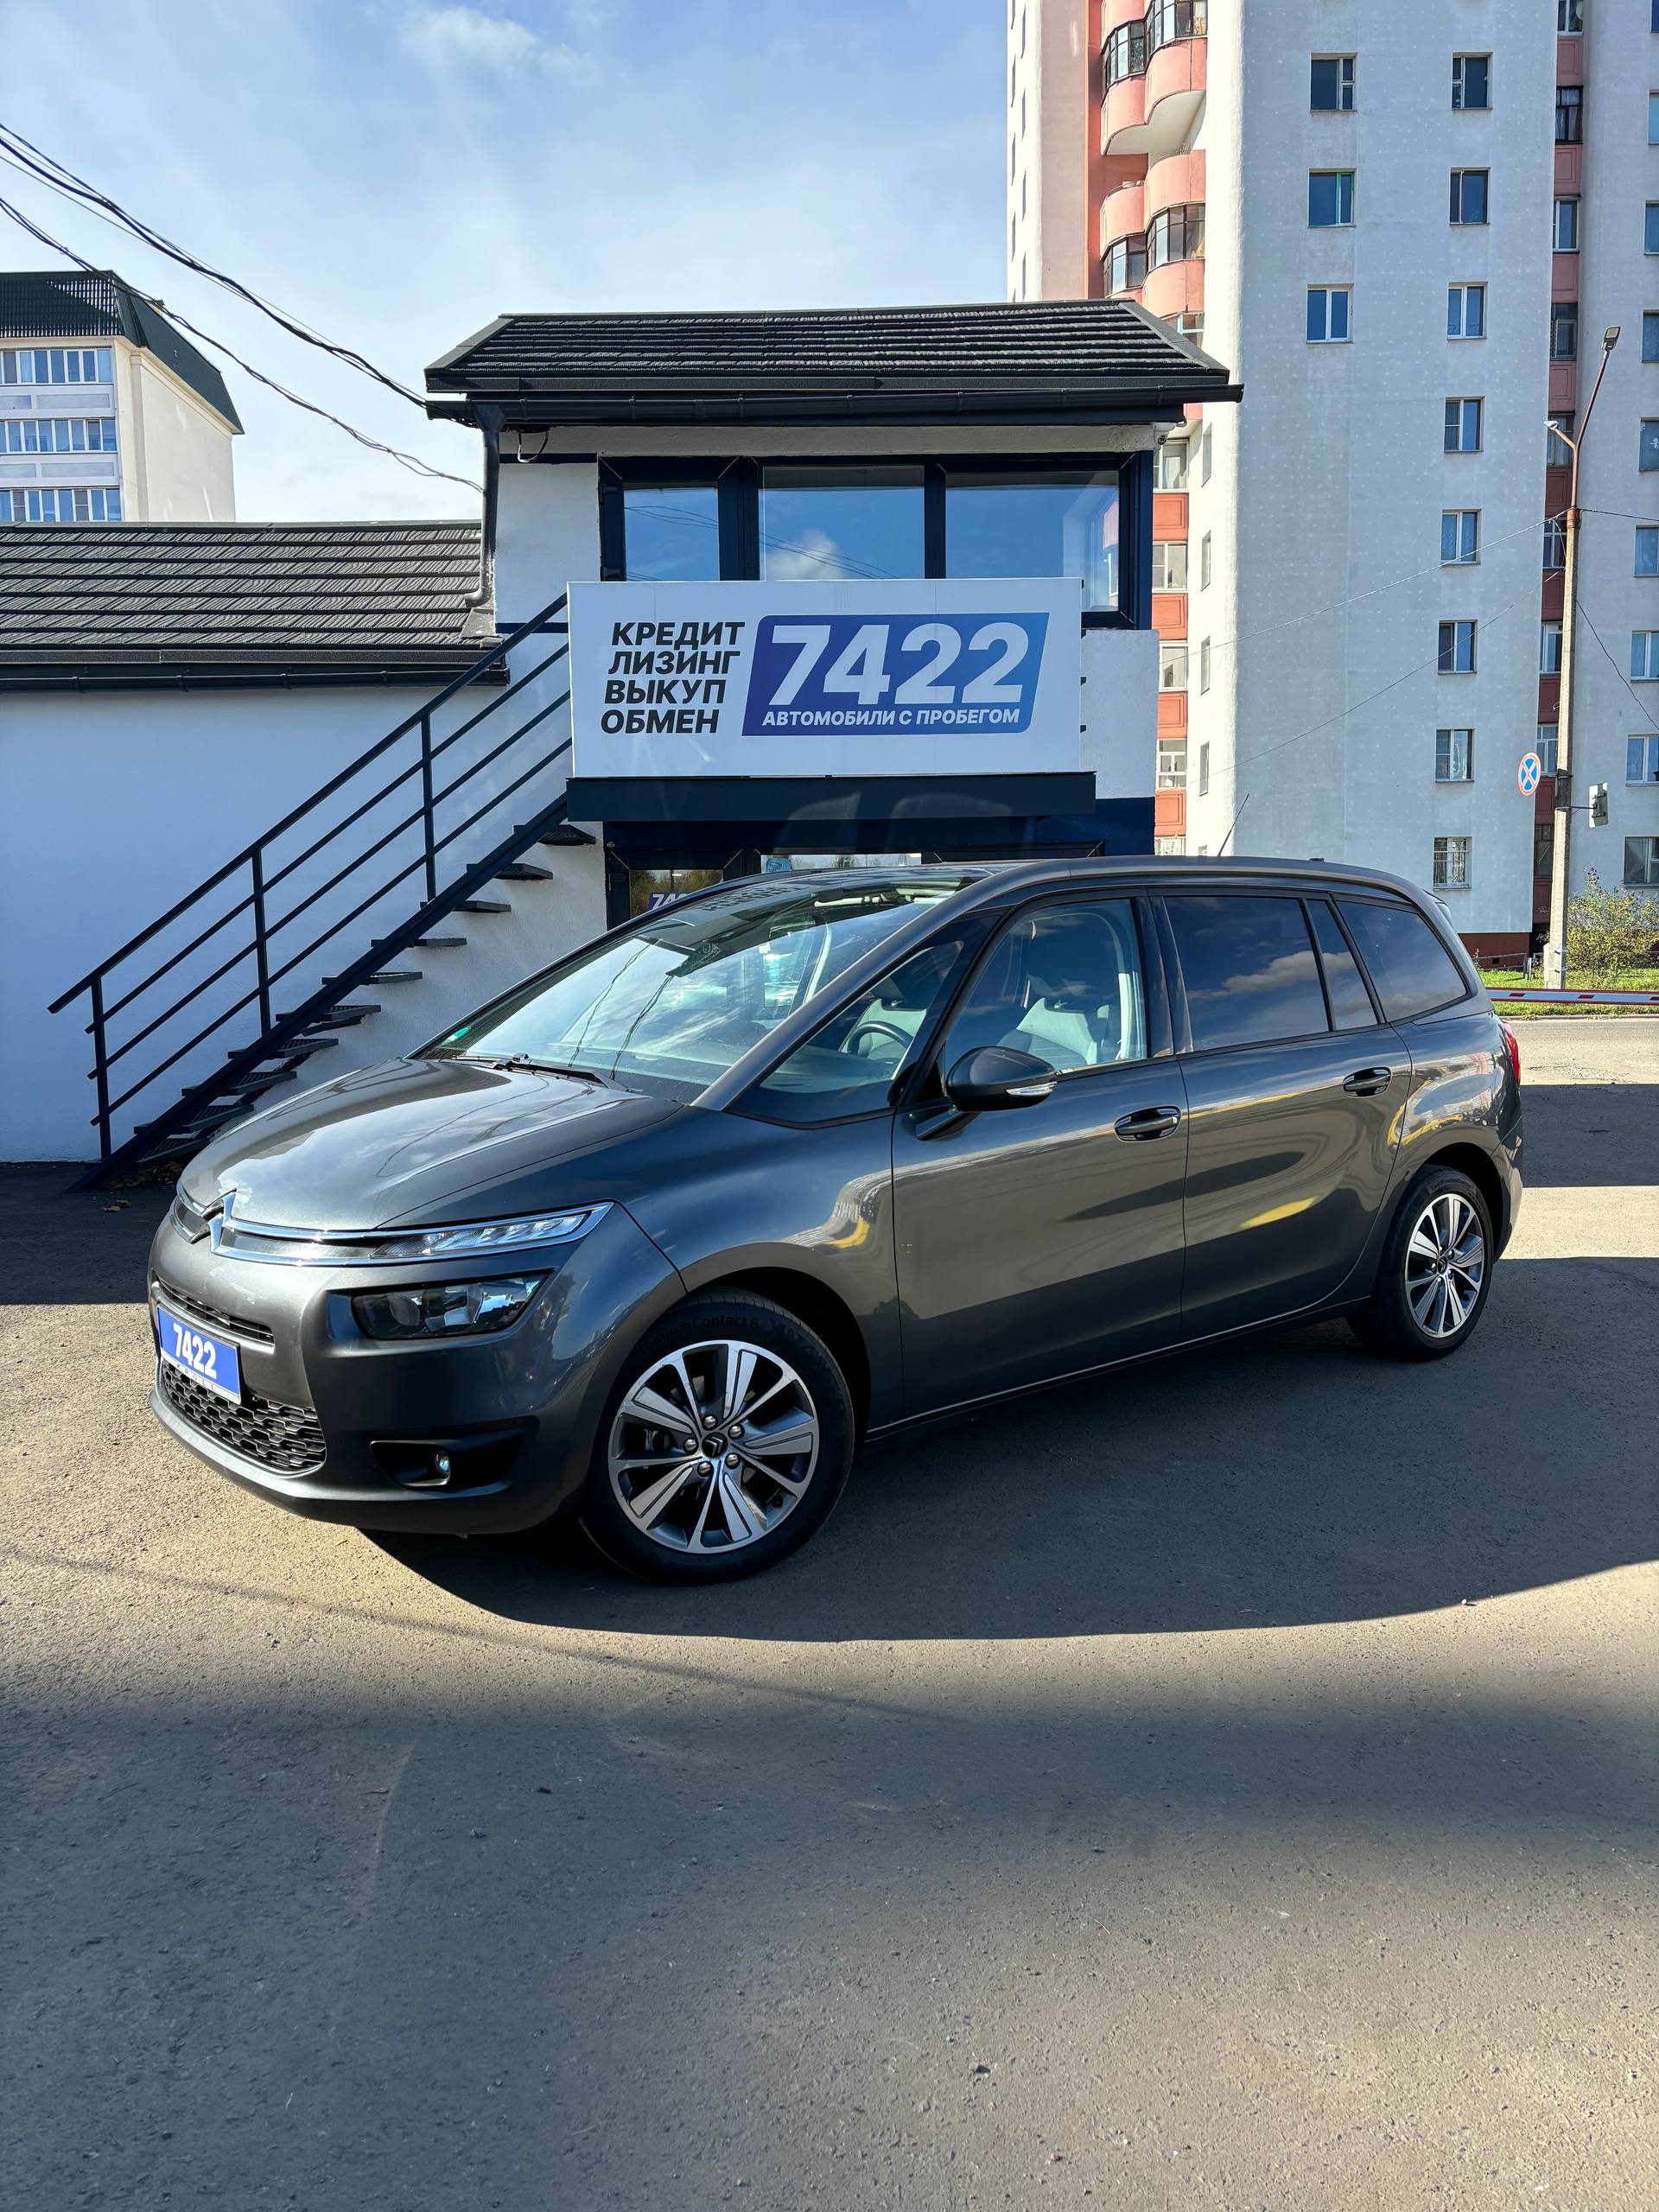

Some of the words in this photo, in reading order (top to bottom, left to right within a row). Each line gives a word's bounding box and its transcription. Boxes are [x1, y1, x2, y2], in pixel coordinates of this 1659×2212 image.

[611, 621, 746, 651] КРЕДИТ
[607, 651, 741, 675] ЛИЗИНГ
[768, 622, 1029, 706] 7422
[604, 679, 727, 704] ВЫКУП
[601, 709, 720, 734] ОБМЕН
[761, 710, 896, 726] АВТОМОБИЛИ
[899, 710, 912, 725] С
[916, 709, 1020, 725] ПРОБЕГОМ
[173, 1322, 217, 1379] 7422
